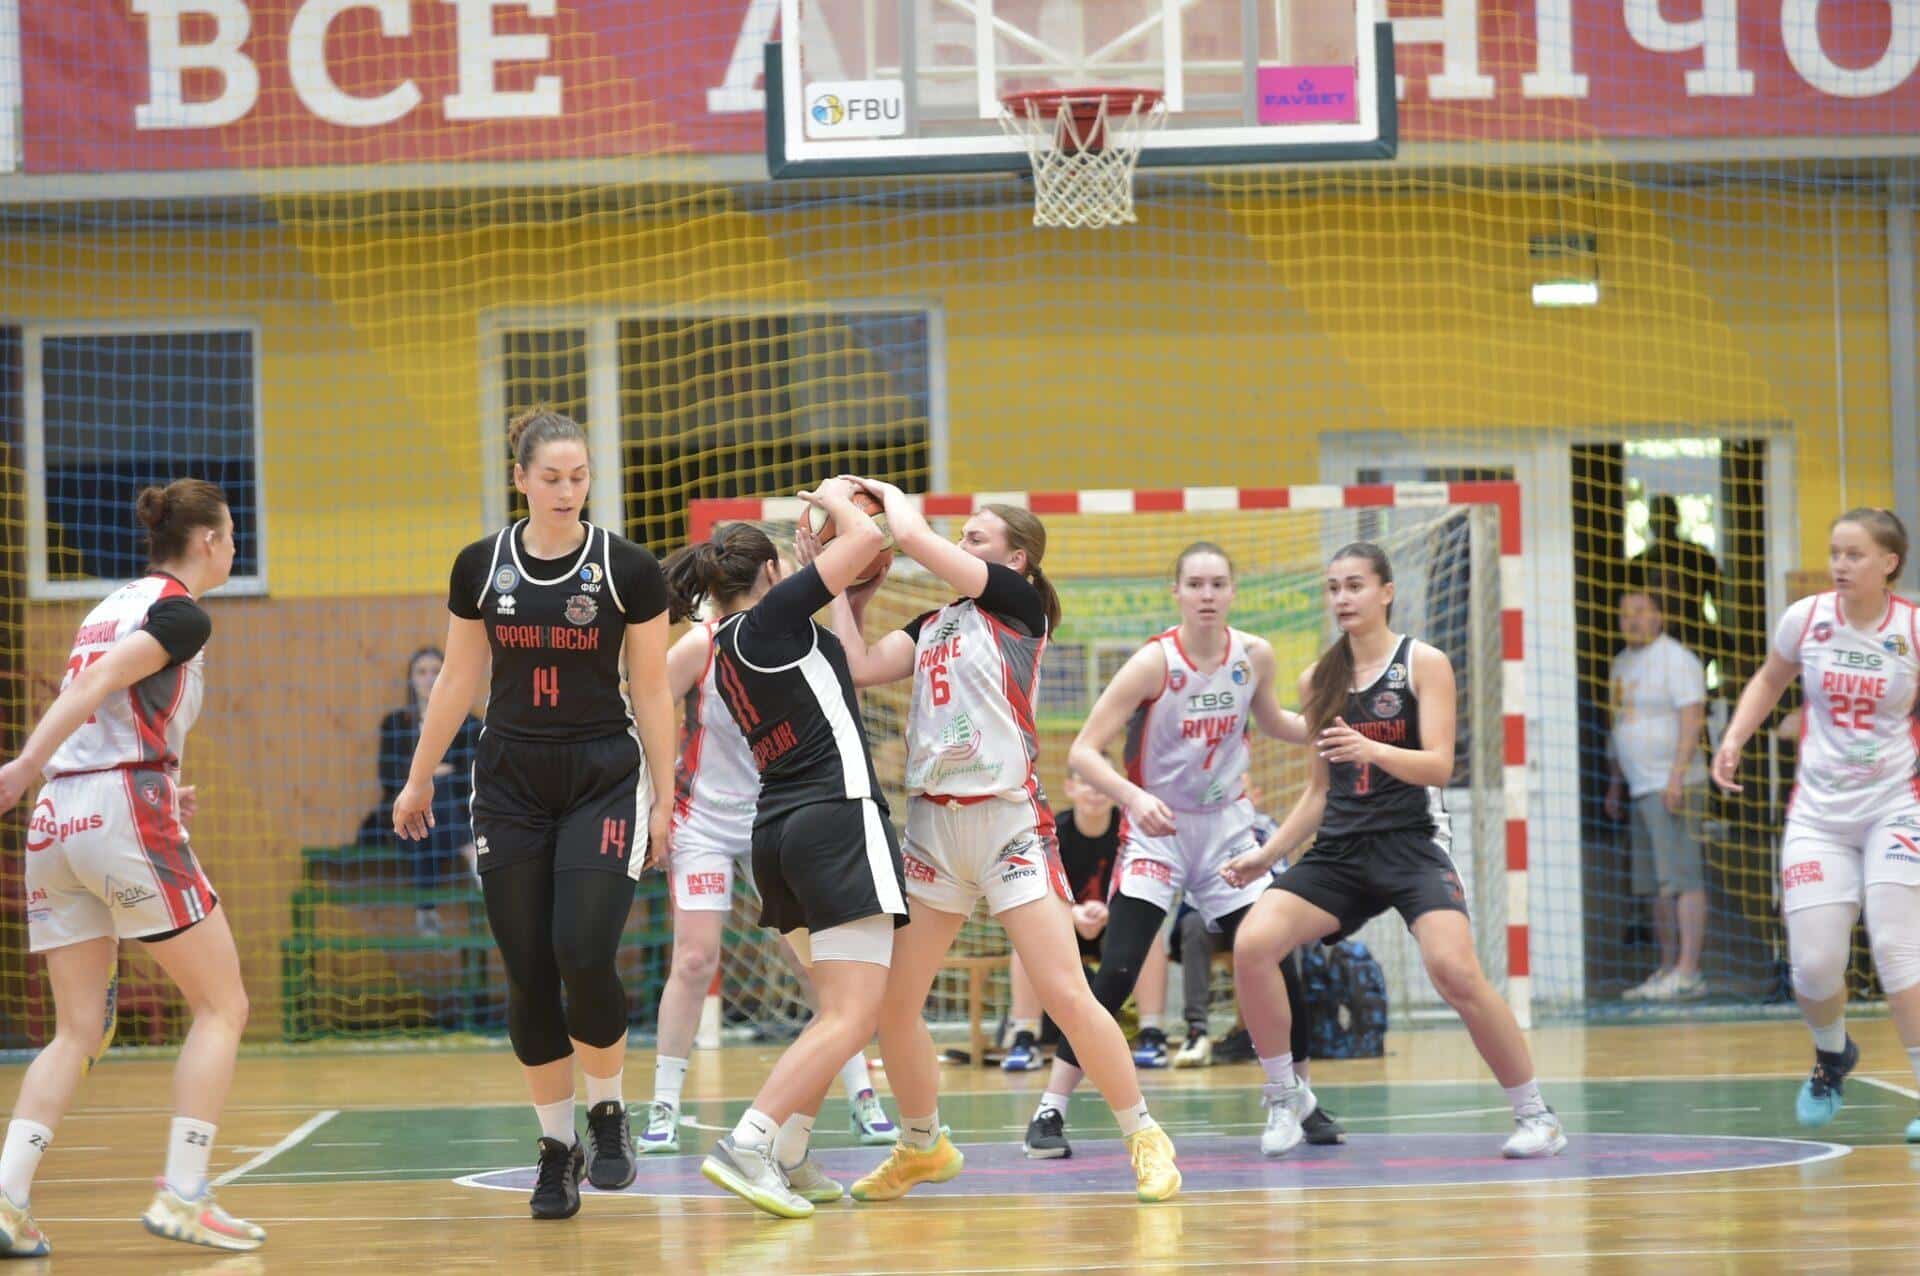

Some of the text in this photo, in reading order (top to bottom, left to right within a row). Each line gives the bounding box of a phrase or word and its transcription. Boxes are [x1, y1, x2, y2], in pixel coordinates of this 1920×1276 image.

[134, 0, 563, 130] ВСЕ
[847, 98, 901, 122] FBU
[581, 583, 602, 593] ФБУ
[1833, 649, 1884, 667] TBG
[532, 665, 560, 708] 14
[929, 664, 951, 708] 6
[1822, 671, 1888, 699] RIVNE
[1188, 691, 1235, 708] TBG
[1828, 693, 1878, 731] 22
[1202, 738, 1223, 771] 7
[600, 816, 627, 859] 14
[686, 872, 726, 885] INTER
[1001, 868, 1037, 884] imtrex
[688, 885, 726, 896] BETON
